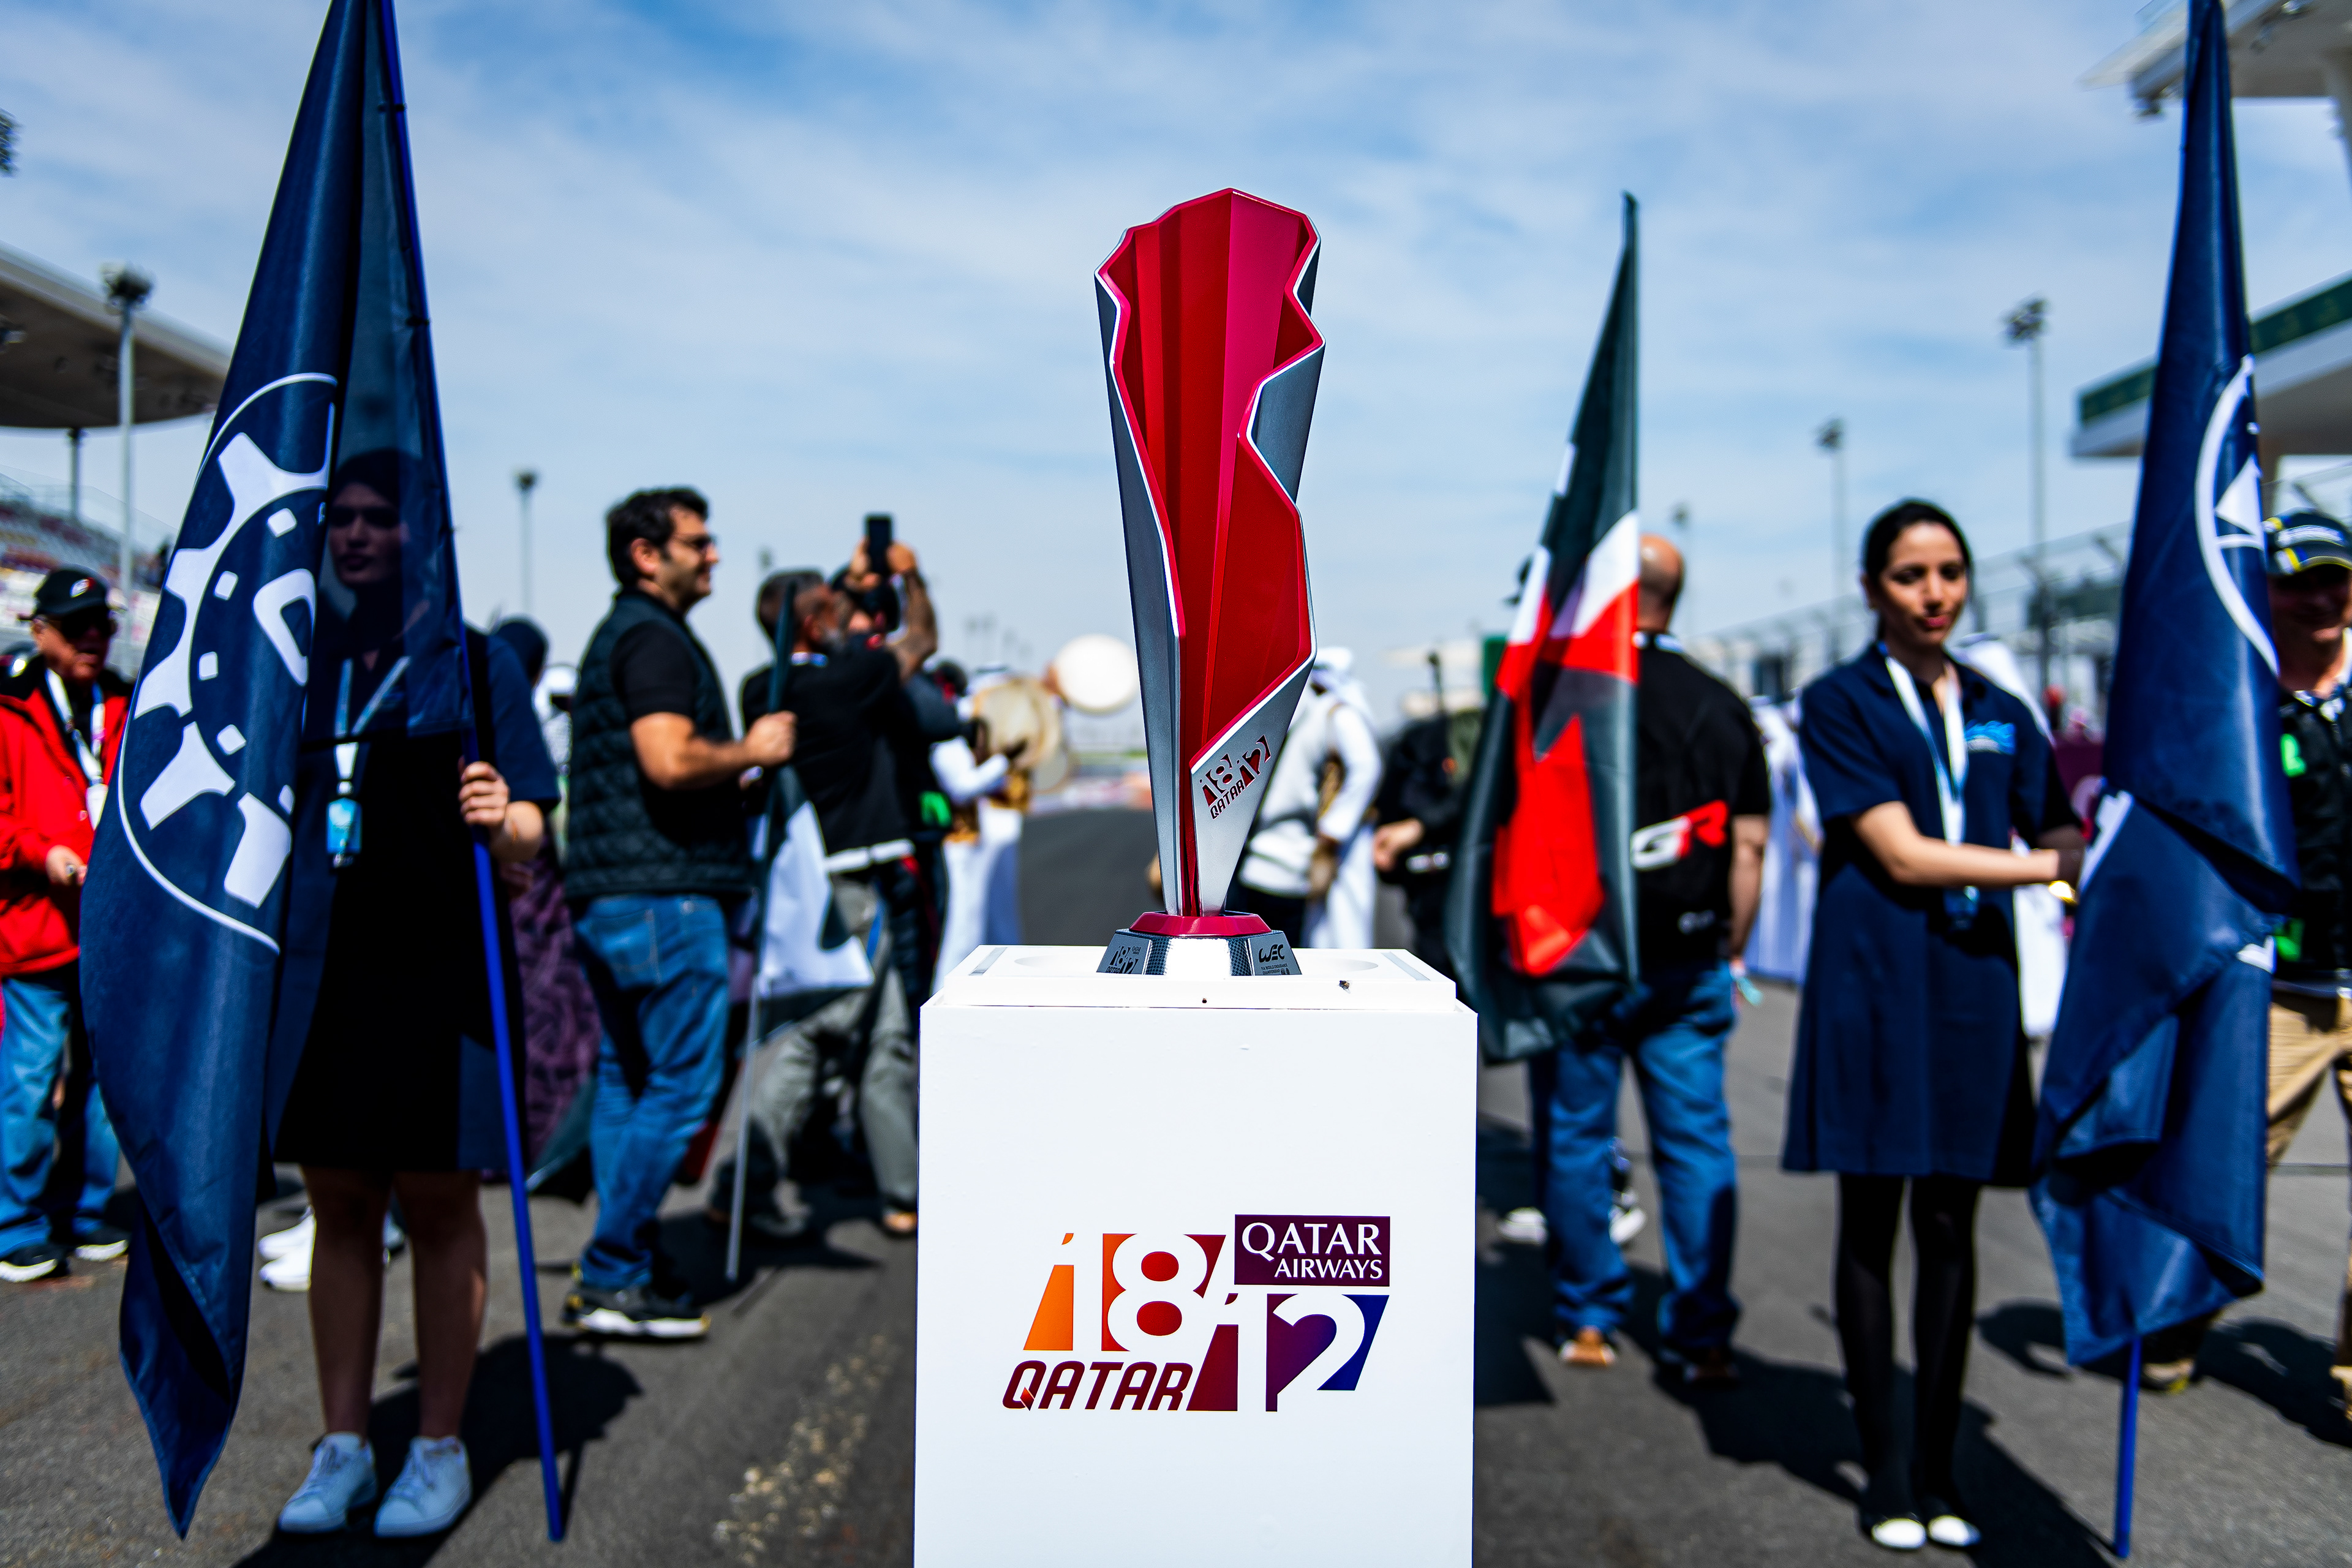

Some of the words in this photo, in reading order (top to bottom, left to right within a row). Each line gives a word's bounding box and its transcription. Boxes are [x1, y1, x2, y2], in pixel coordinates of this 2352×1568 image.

[1210, 779, 1245, 820] QATAR
[1258, 944, 1284, 963] WEC
[1242, 1222, 1381, 1261] QATAR
[1275, 1259, 1382, 1279] AIRWAYS
[1002, 1360, 1193, 1411] QATAR
